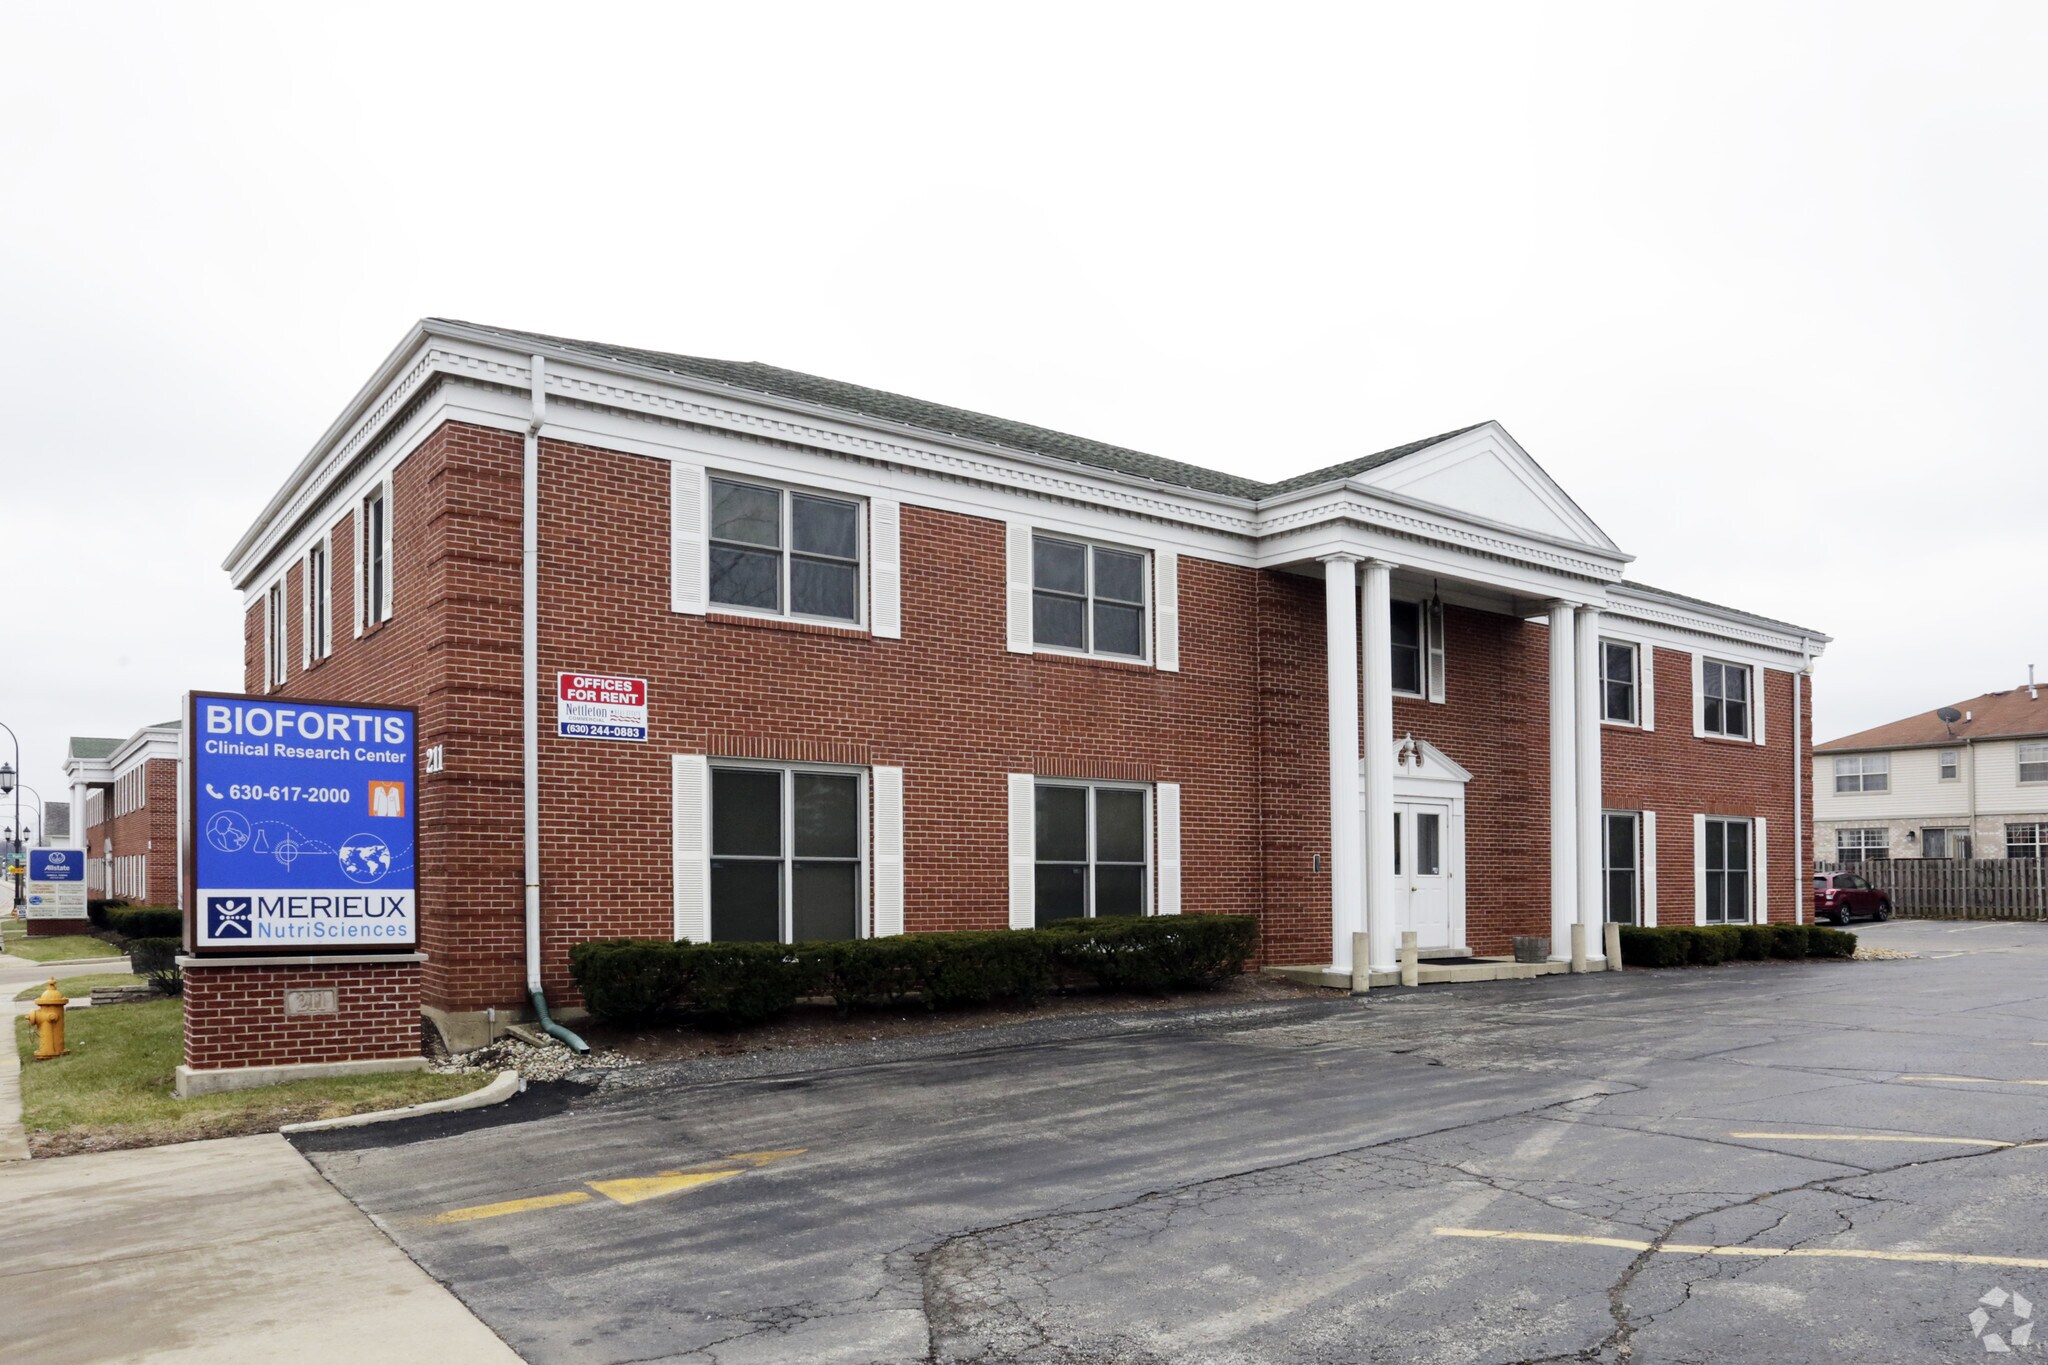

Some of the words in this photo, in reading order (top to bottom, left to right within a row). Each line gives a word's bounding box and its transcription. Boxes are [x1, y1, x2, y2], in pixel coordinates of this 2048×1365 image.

[573, 677, 632, 692] OFFICES
[567, 689, 596, 701] FOR
[600, 691, 638, 704] RENT
[566, 703, 607, 718] Nettleton
[206, 705, 406, 744] BIOFORTIS
[567, 724, 588, 735] (630)
[590, 725, 639, 737] 244-0883
[205, 740, 269, 756] Clinical
[274, 743, 350, 761] Research
[355, 748, 406, 763] Center
[426, 744, 443, 773] 211
[229, 784, 350, 804] 630-617-2000
[258, 896, 406, 918] MERIEUX
[258, 921, 407, 938] NutriSciences
[296, 991, 325, 1011] 211
